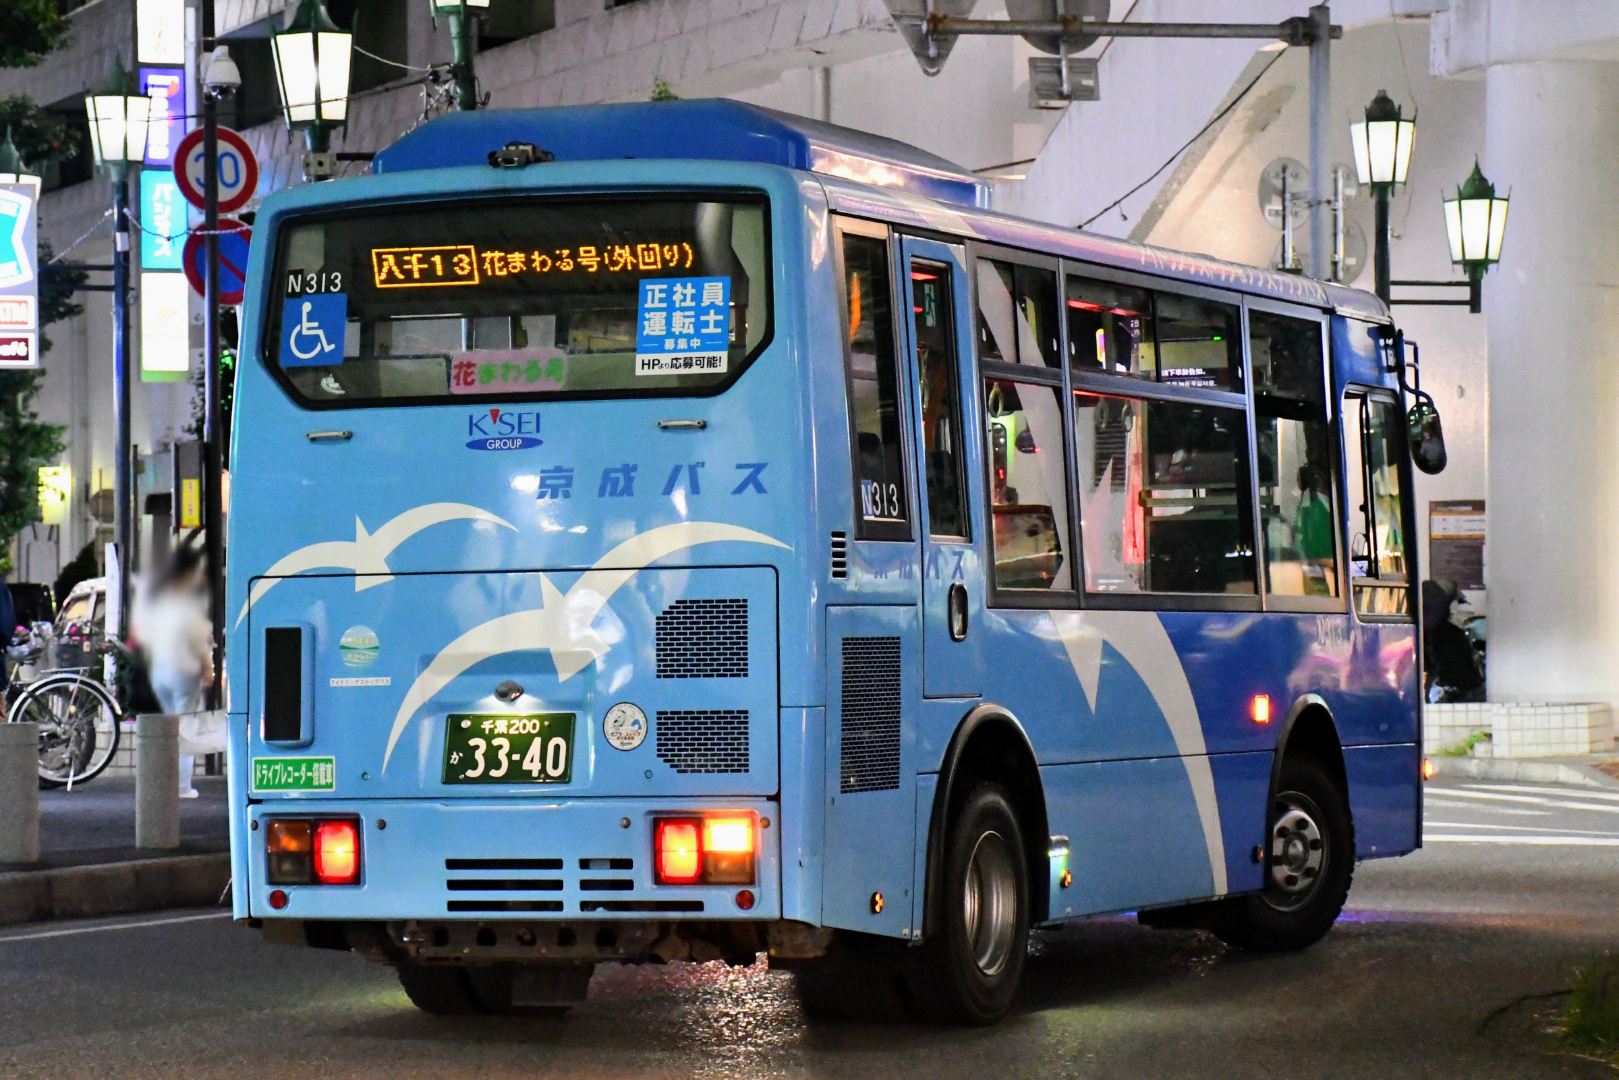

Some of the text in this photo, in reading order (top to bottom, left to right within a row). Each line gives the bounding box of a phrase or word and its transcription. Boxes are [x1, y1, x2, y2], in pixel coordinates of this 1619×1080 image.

[482, 242, 693, 276] 花まわる号(外回り)
[288, 272, 342, 294] N313
[644, 281, 724, 308] 正社員
[643, 309, 724, 337] 運転士
[0, 341, 28, 356] afé
[664, 337, 701, 350] 募集中
[453, 357, 565, 386] 花まわる号
[486, 437, 523, 451] GROUP
[536, 461, 770, 499] 京成バス
[861, 481, 899, 517] N313
[449, 736, 567, 778] か 33-40
[256, 761, 333, 786] ドライブレコーダー搭載車
